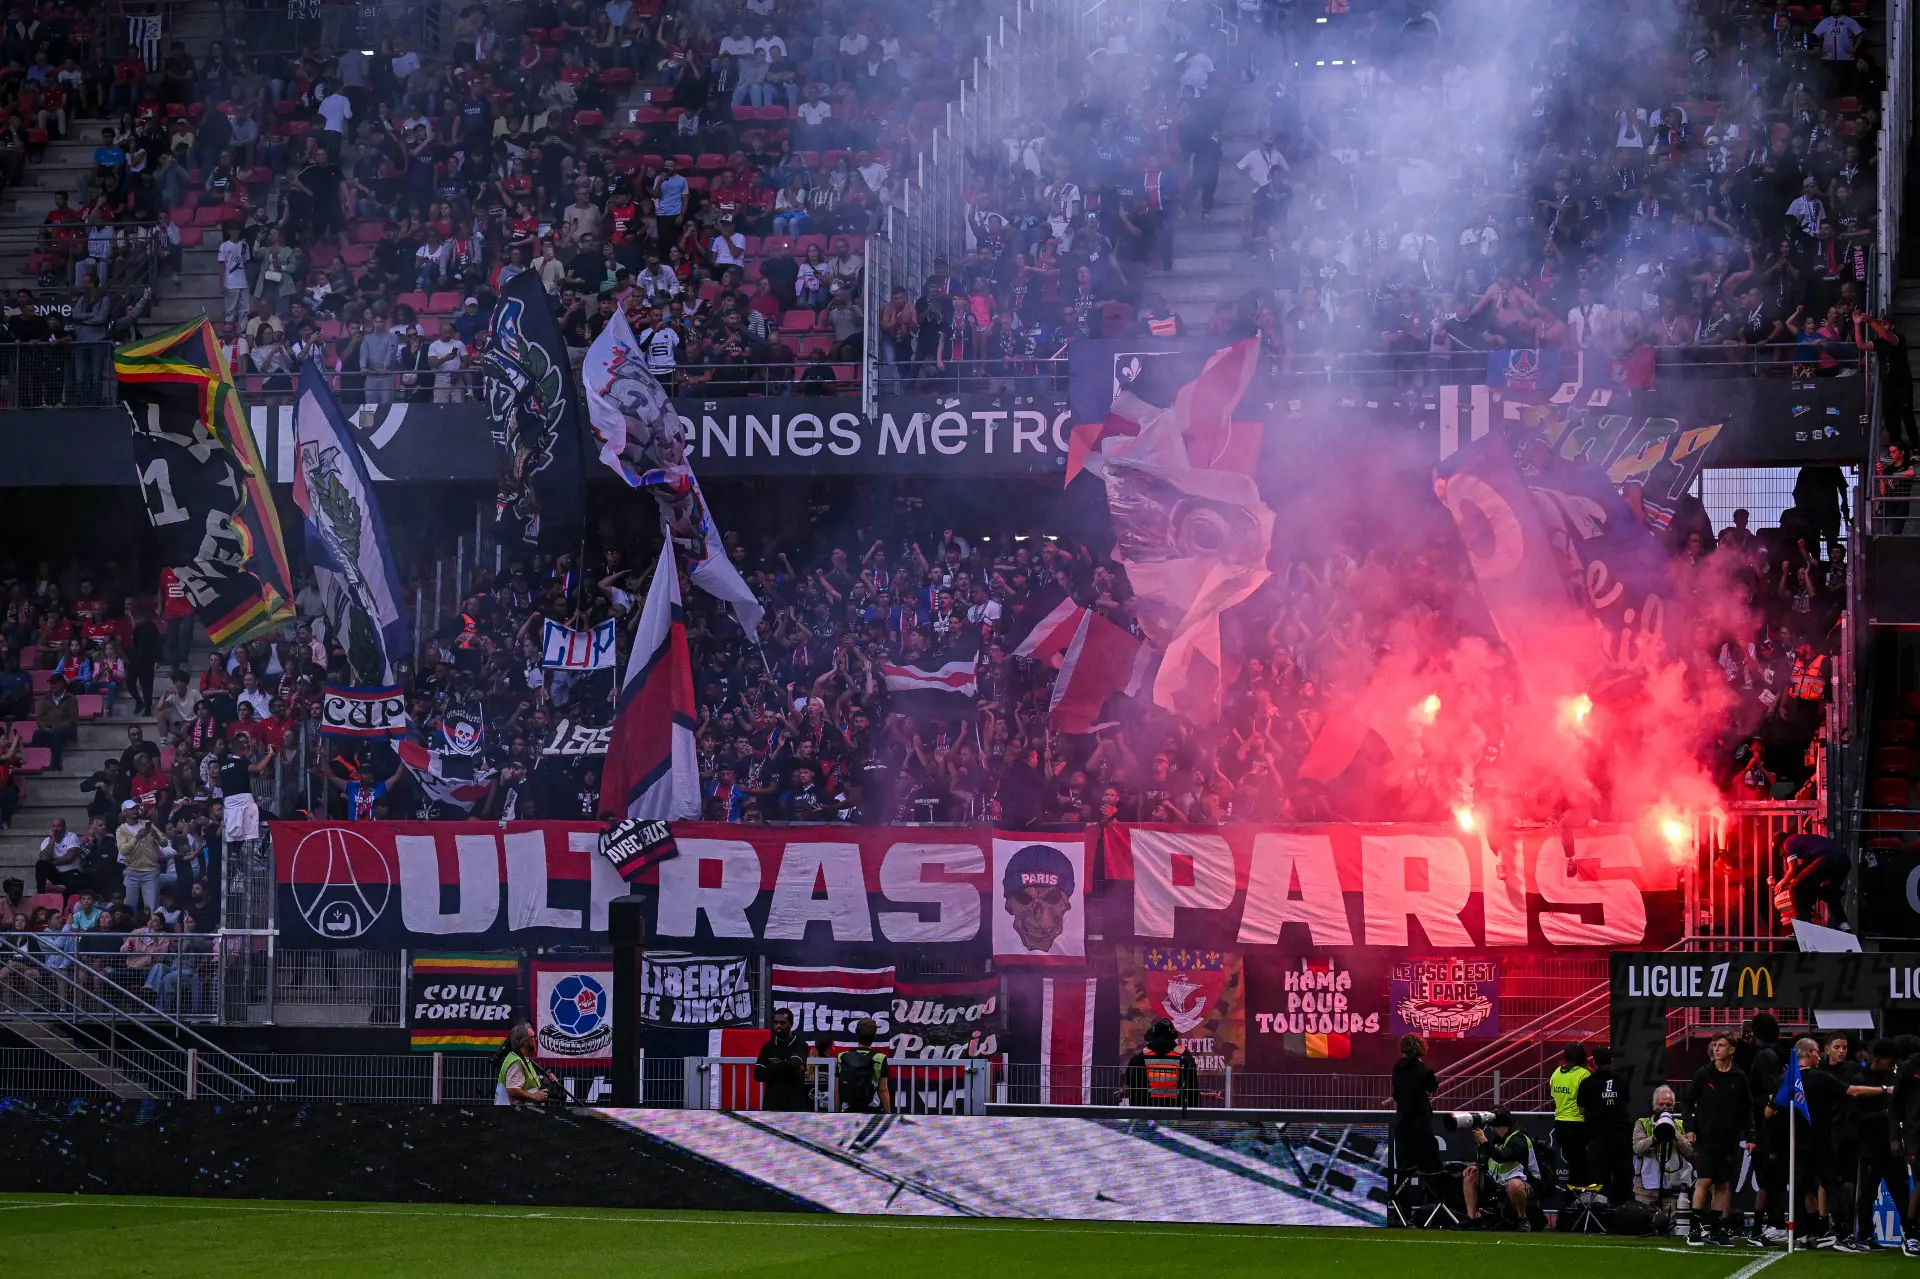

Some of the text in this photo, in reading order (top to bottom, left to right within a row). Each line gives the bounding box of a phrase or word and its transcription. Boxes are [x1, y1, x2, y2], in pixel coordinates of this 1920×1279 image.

[543, 621, 615, 666] CUP
[606, 833, 643, 864] AVEC
[395, 829, 986, 943] ULTRAS
[1021, 873, 1058, 885] PARIS
[1130, 828, 1647, 947] PARIS
[641, 959, 749, 998] LIBEREZ
[1393, 963, 1411, 981] LE
[1414, 963, 1447, 982] PSG
[1628, 965, 1703, 998] LIGUE
[424, 985, 504, 1001] COULY
[1287, 992, 1348, 1013] POUR
[1410, 981, 1477, 1000] LE PARC
[415, 1003, 512, 1020] FOREVER
[773, 1000, 890, 1034] Ultras
[891, 996, 996, 1025] Ultras
[1255, 1012, 1380, 1034] TOUJOURS
[889, 1030, 998, 1060] Paris
